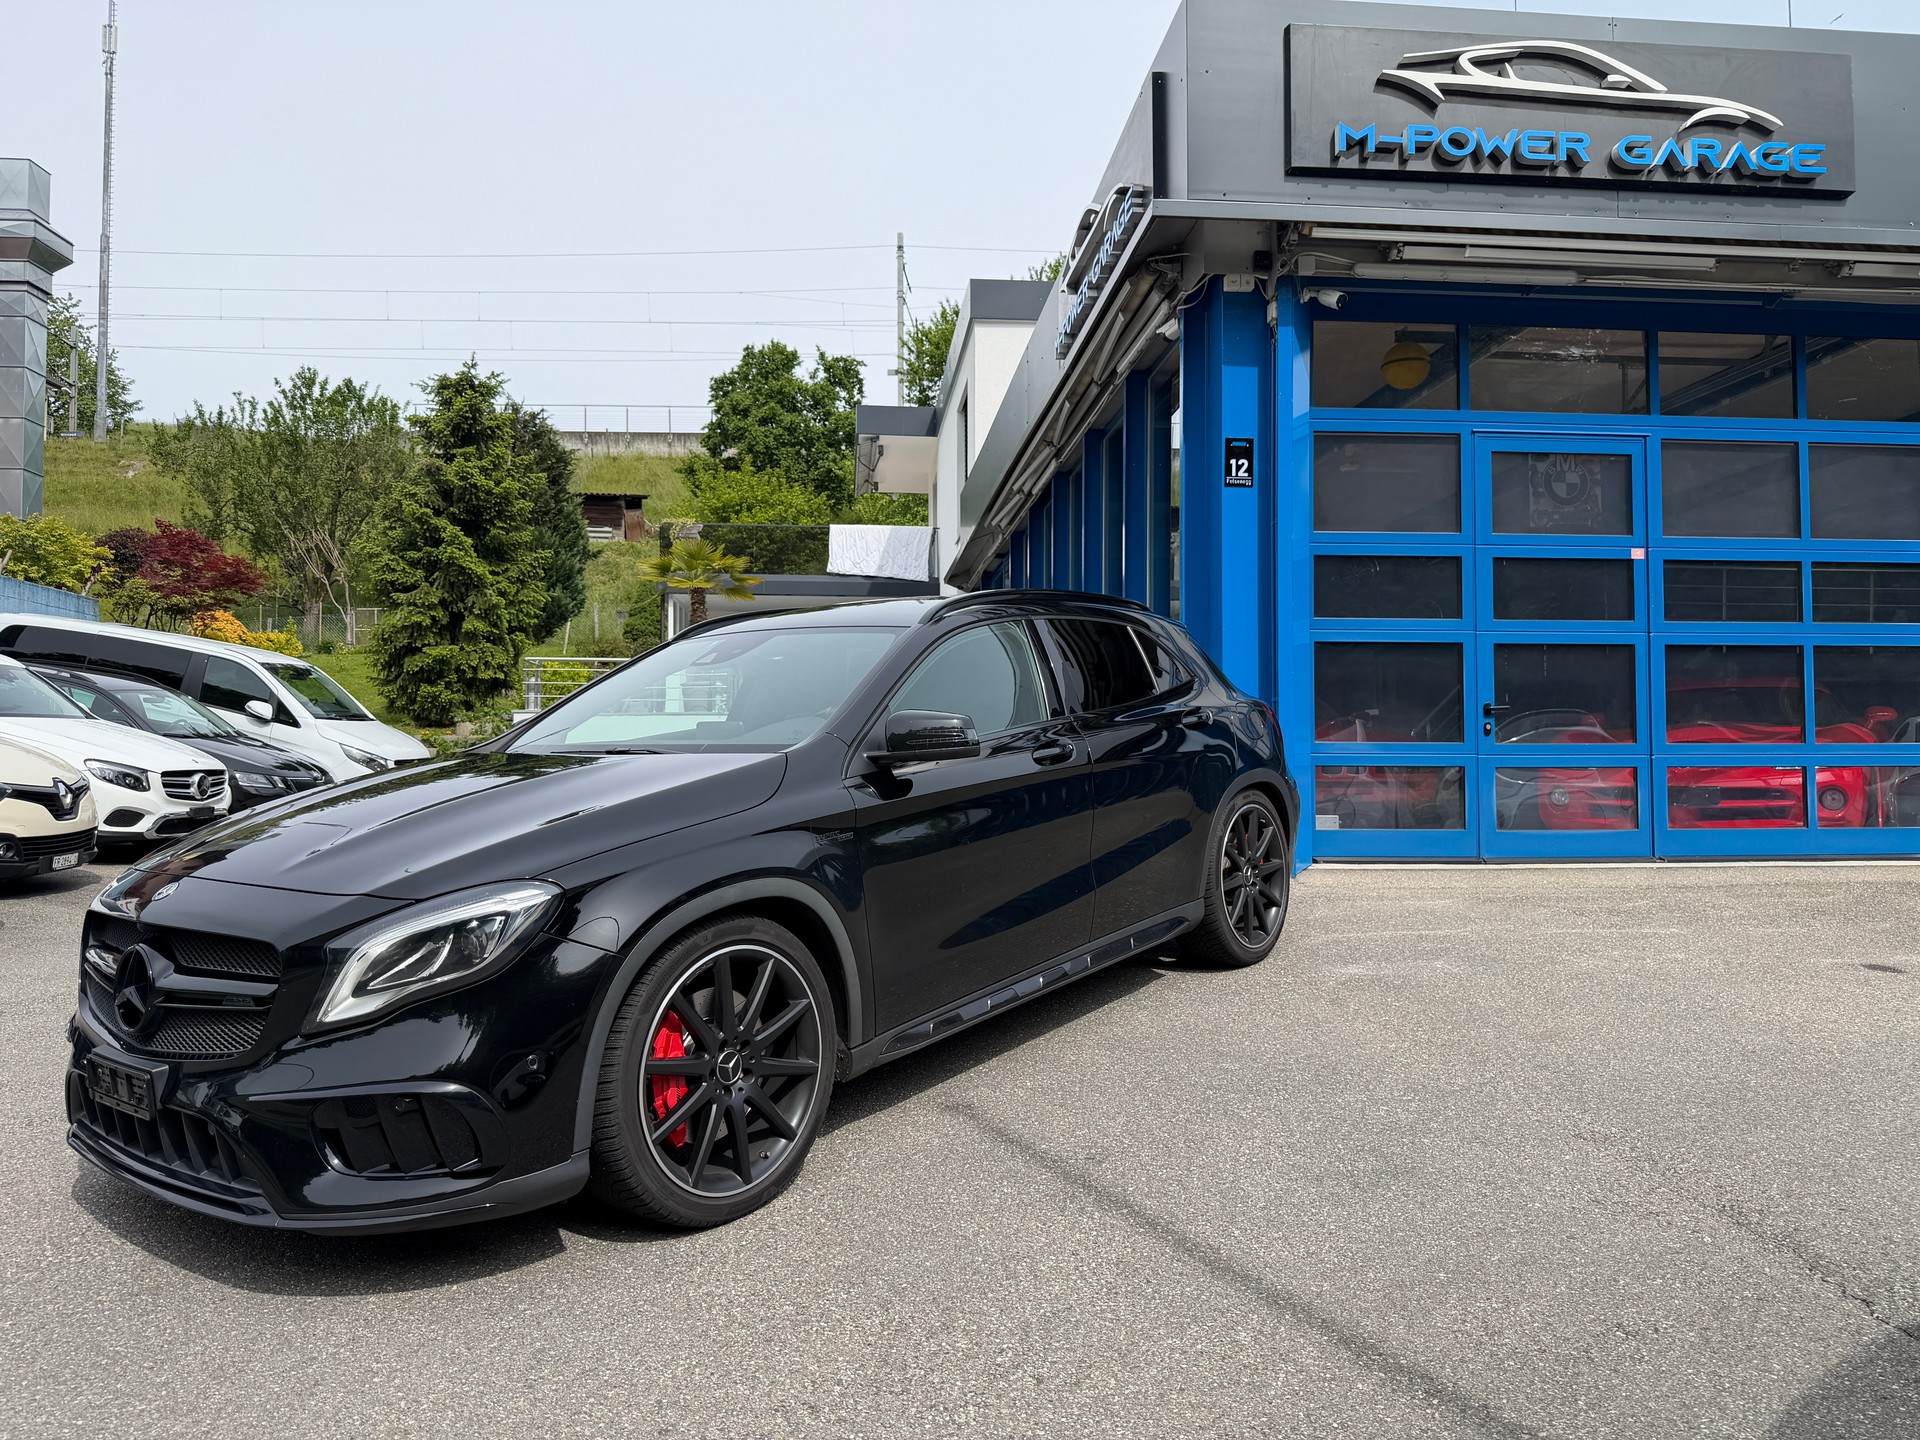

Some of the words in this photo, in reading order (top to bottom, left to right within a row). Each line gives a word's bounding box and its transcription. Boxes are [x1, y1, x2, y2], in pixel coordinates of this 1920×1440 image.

[1338, 121, 1591, 163] M-POWER
[1617, 134, 1828, 174] GARAGE
[1091, 184, 1134, 285] GARAGE
[1229, 458, 1249, 477] 12
